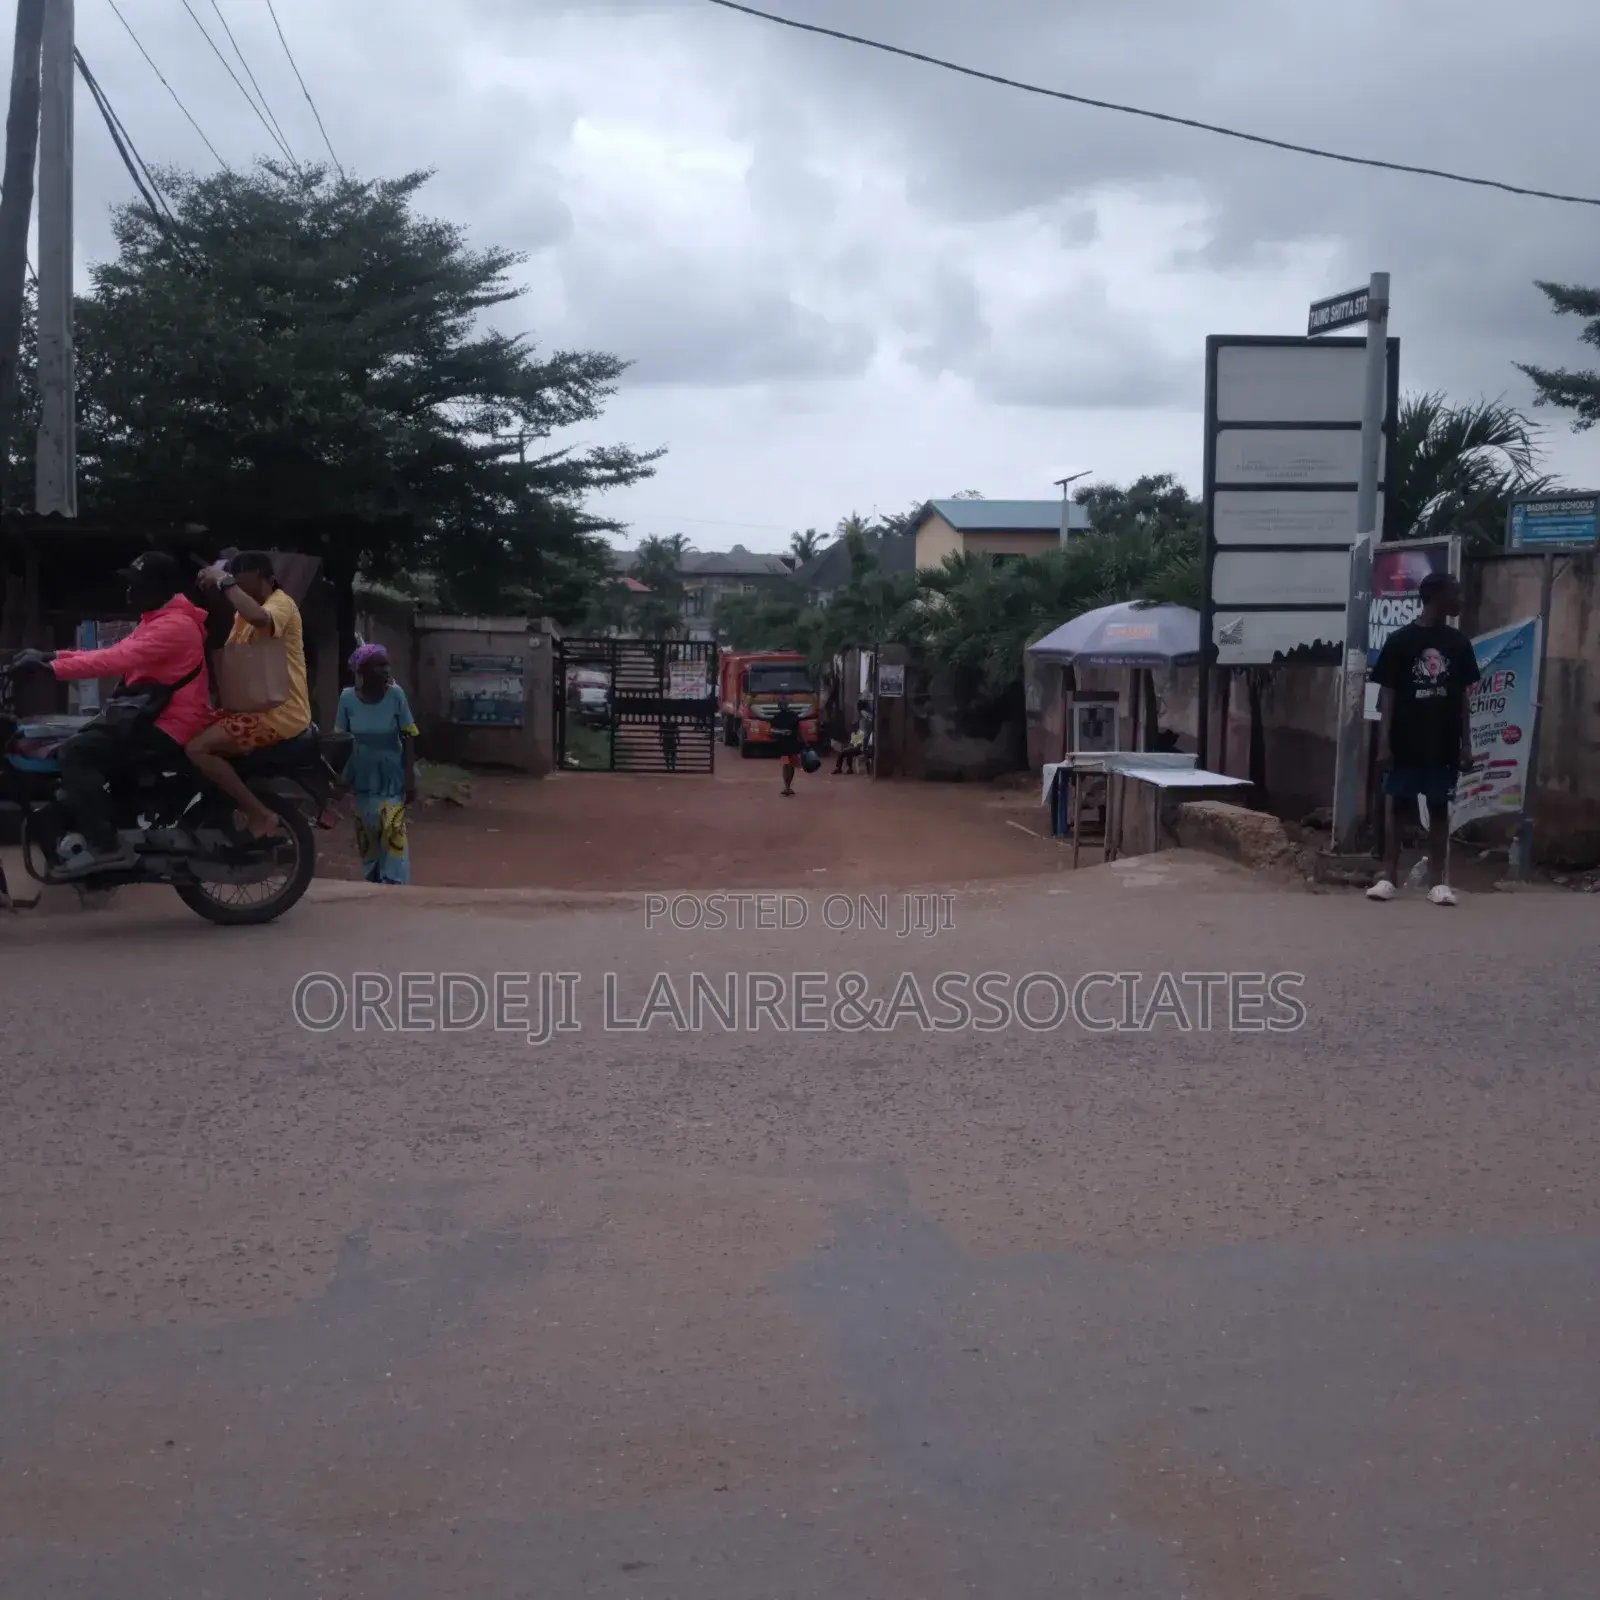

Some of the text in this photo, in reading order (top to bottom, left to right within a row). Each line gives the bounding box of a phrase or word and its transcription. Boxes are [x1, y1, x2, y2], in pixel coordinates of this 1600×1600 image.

[1310, 306, 1330, 328] TAIWO
[1330, 300, 1354, 322] SHITTA
[1560, 500, 1595, 510] SCHOOLS
